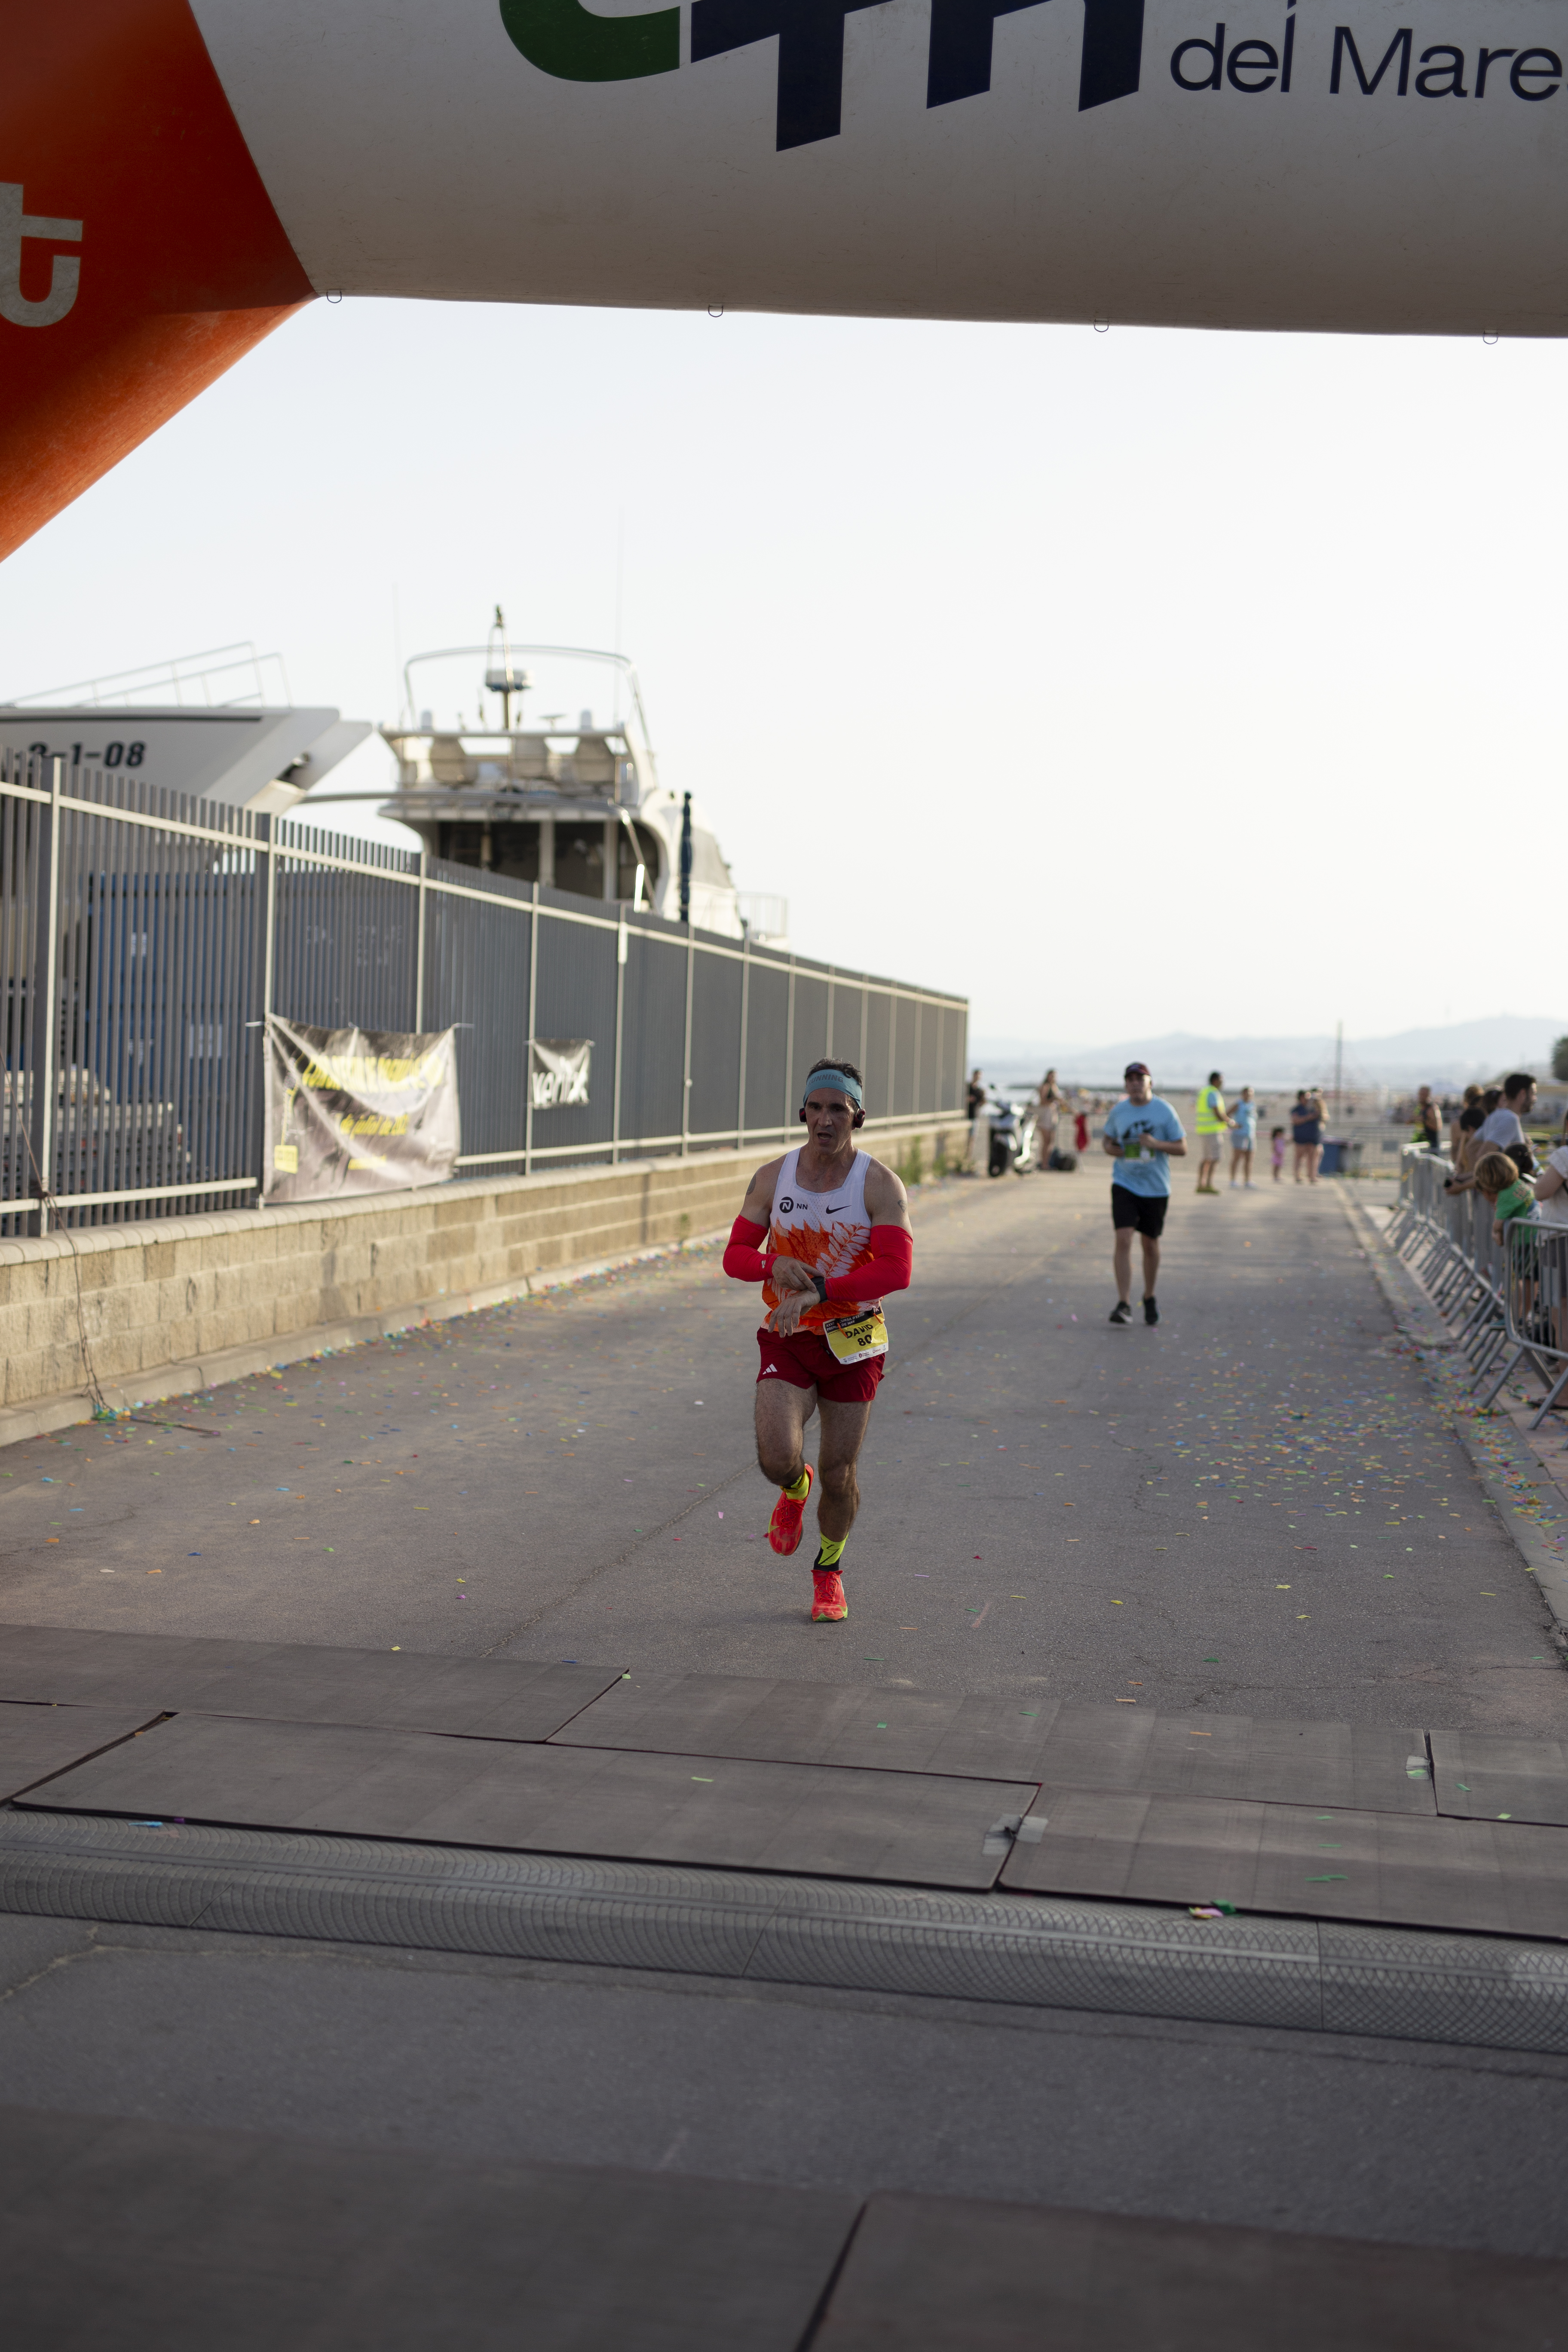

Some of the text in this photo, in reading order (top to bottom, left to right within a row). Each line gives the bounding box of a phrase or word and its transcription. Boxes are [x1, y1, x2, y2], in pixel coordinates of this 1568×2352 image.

[1170, 12, 1296, 94] del
[1329, 26, 1568, 101] Mare
[808, 1074, 843, 1086] RUNNING
[845, 1324, 873, 1339] DAVID
